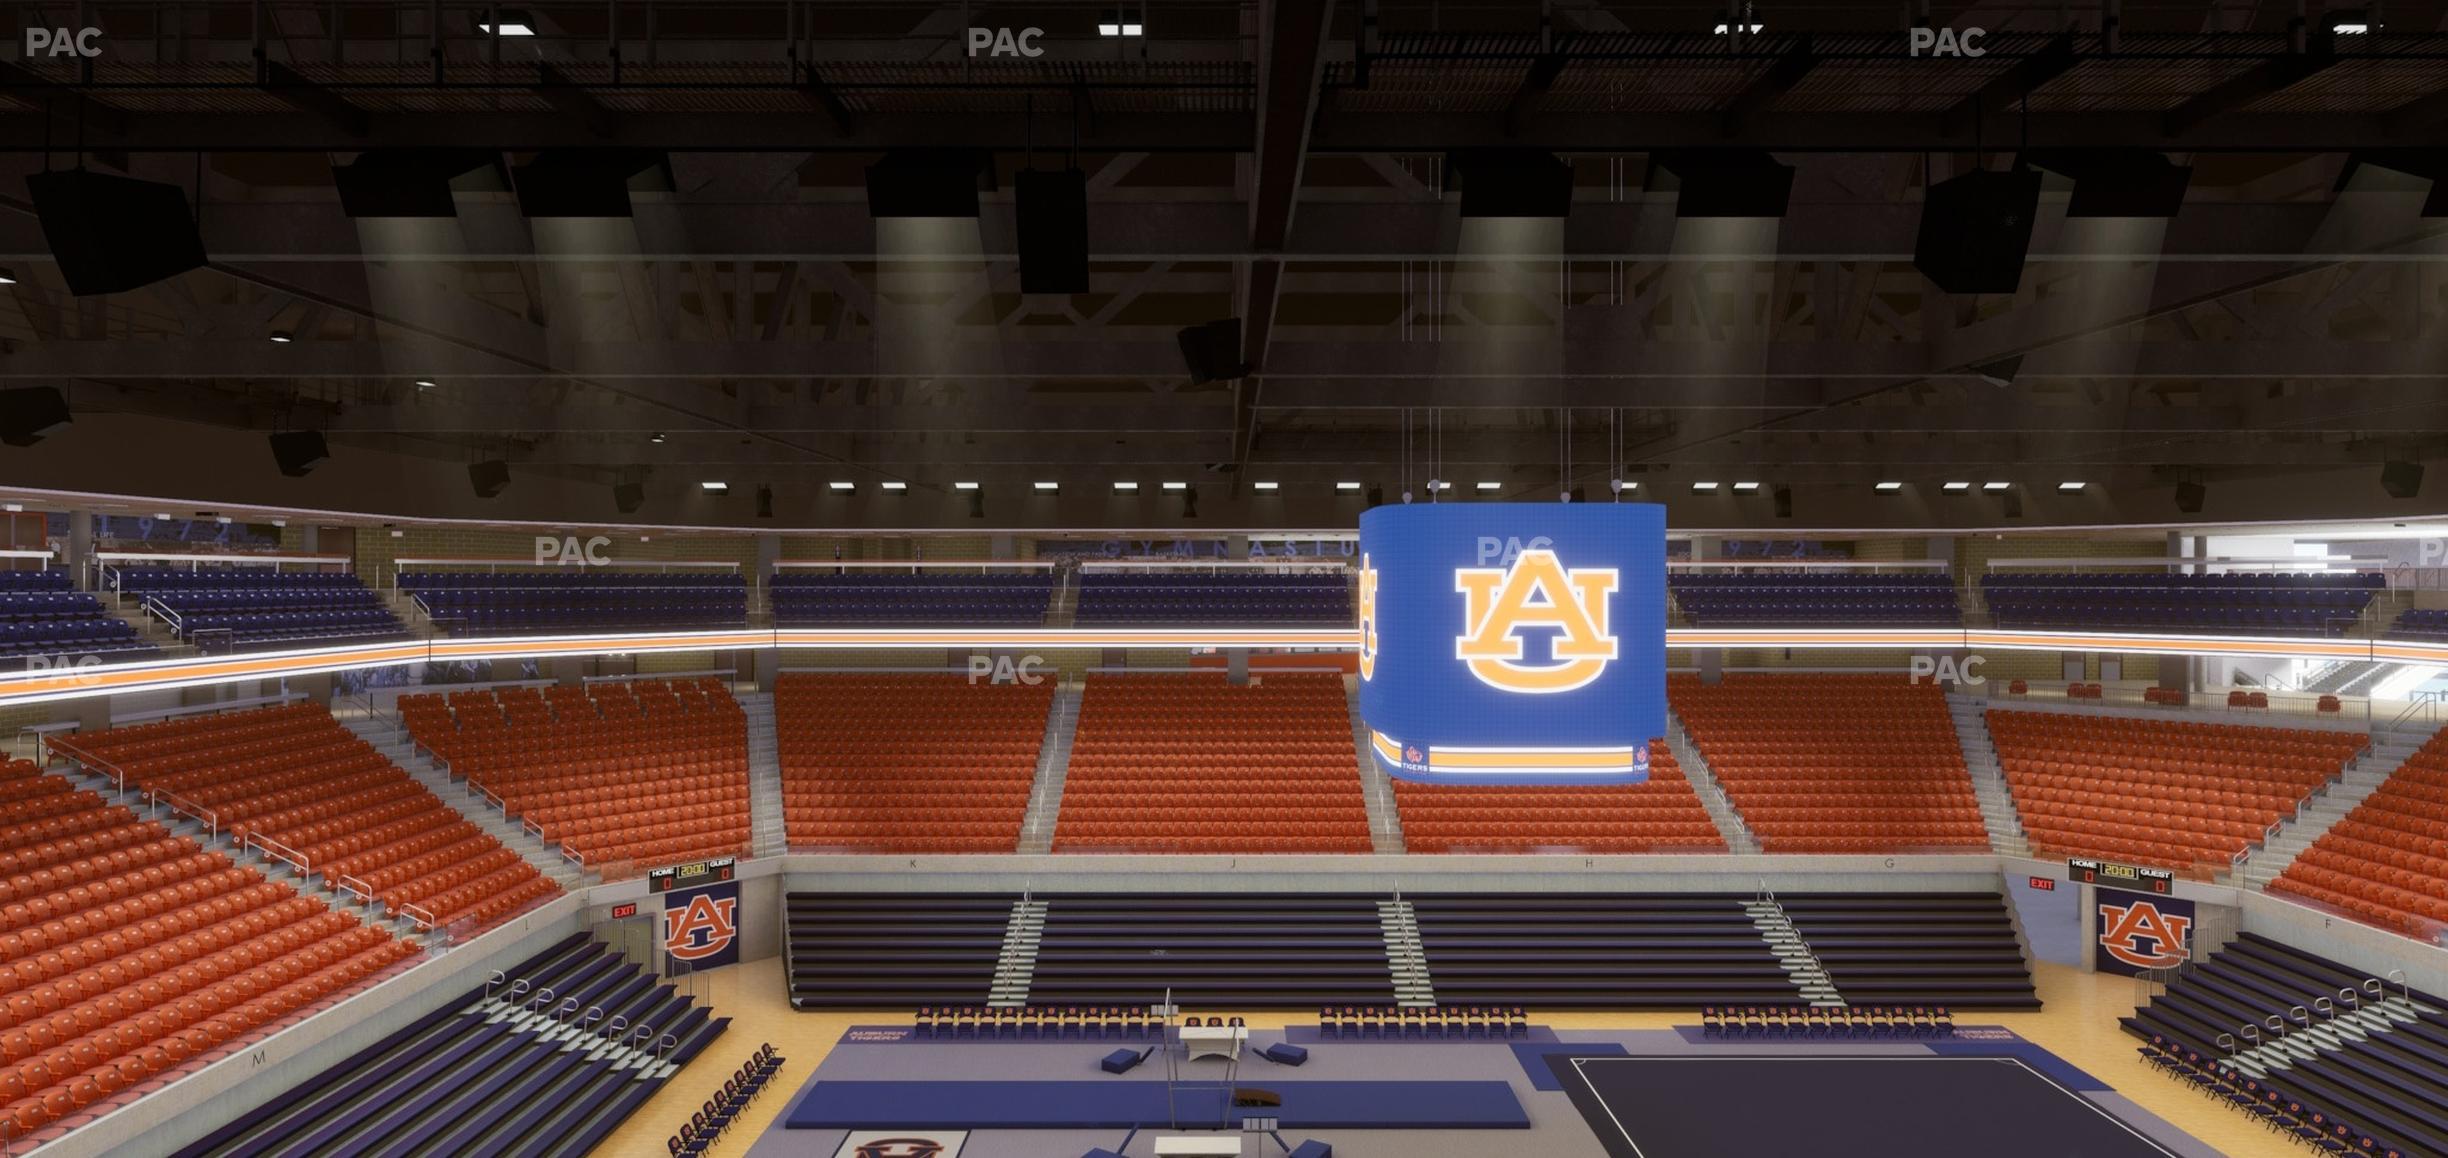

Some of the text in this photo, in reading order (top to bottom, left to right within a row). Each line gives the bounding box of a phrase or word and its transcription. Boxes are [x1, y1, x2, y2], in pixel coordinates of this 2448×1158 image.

[1403, 762, 1428, 772] TIGERS
[652, 858, 733, 877] HOME 20:00 GUEST
[910, 859, 917, 868] K
[1585, 859, 1593, 868] H
[1884, 858, 1895, 868] G
[722, 869, 729, 879] 0
[2071, 859, 2171, 879] HOME 20:00 GUEST
[2086, 871, 2094, 882] 0
[664, 878, 672, 889] 0
[2031, 879, 2054, 890] EXIT
[2156, 881, 2165, 892] 0
[614, 905, 636, 918] EXIT
[2325, 919, 2331, 928] F
[252, 1049, 267, 1067] M
